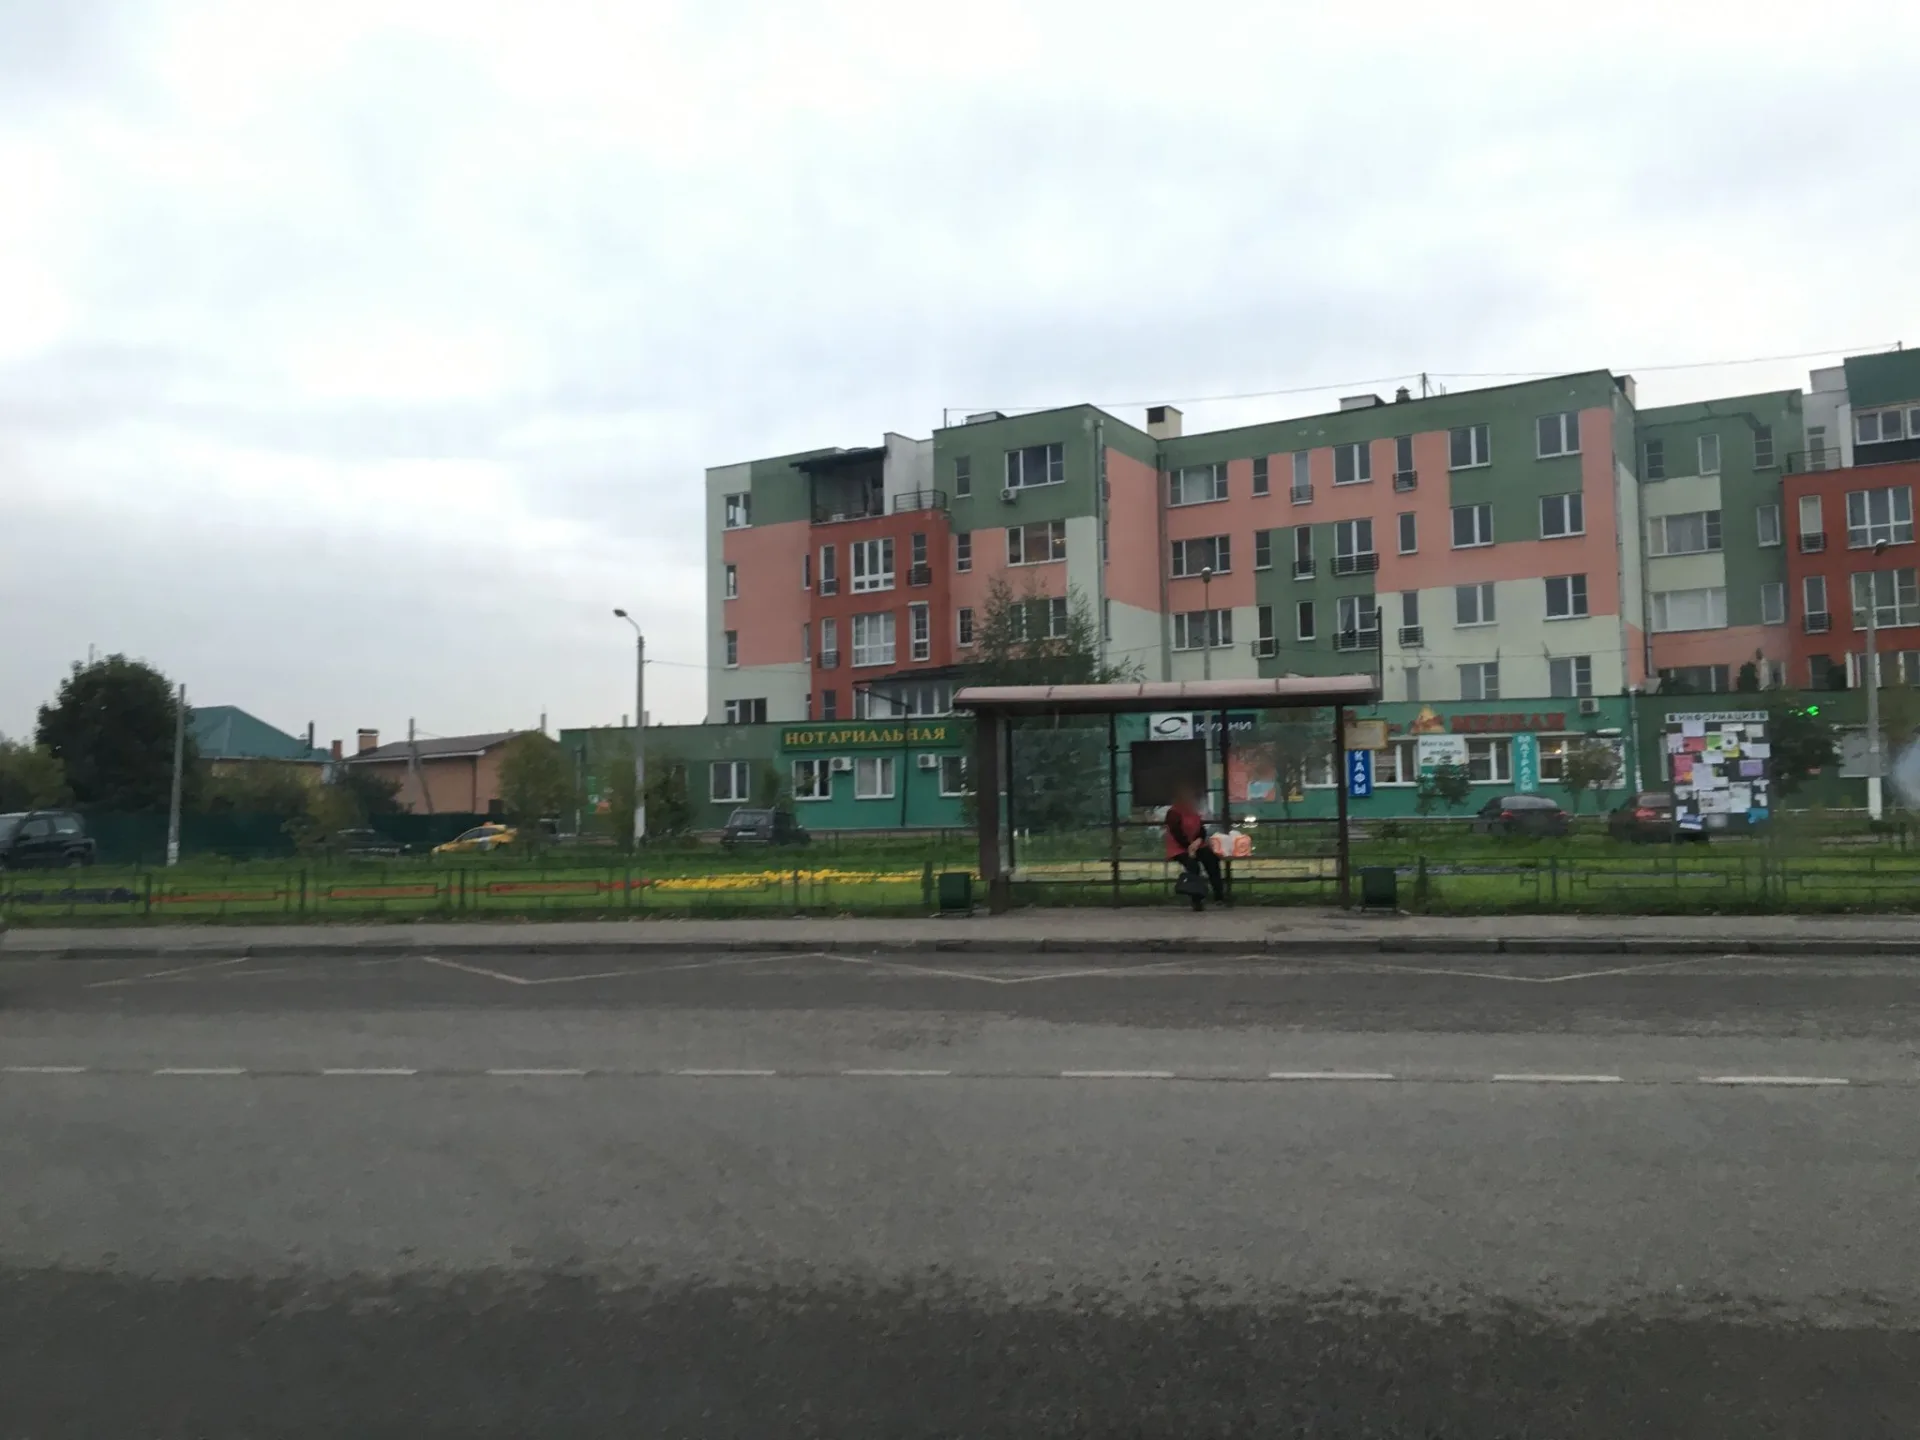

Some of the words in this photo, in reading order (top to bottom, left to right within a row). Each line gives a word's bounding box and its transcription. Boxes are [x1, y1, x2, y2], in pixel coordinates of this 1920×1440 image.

[785, 727, 946, 745] НОТАРИАЛЬНАЯ
[1354, 750, 1367, 795] КАФЫ
[1517, 735, 1533, 791] МАТРАСЫ
